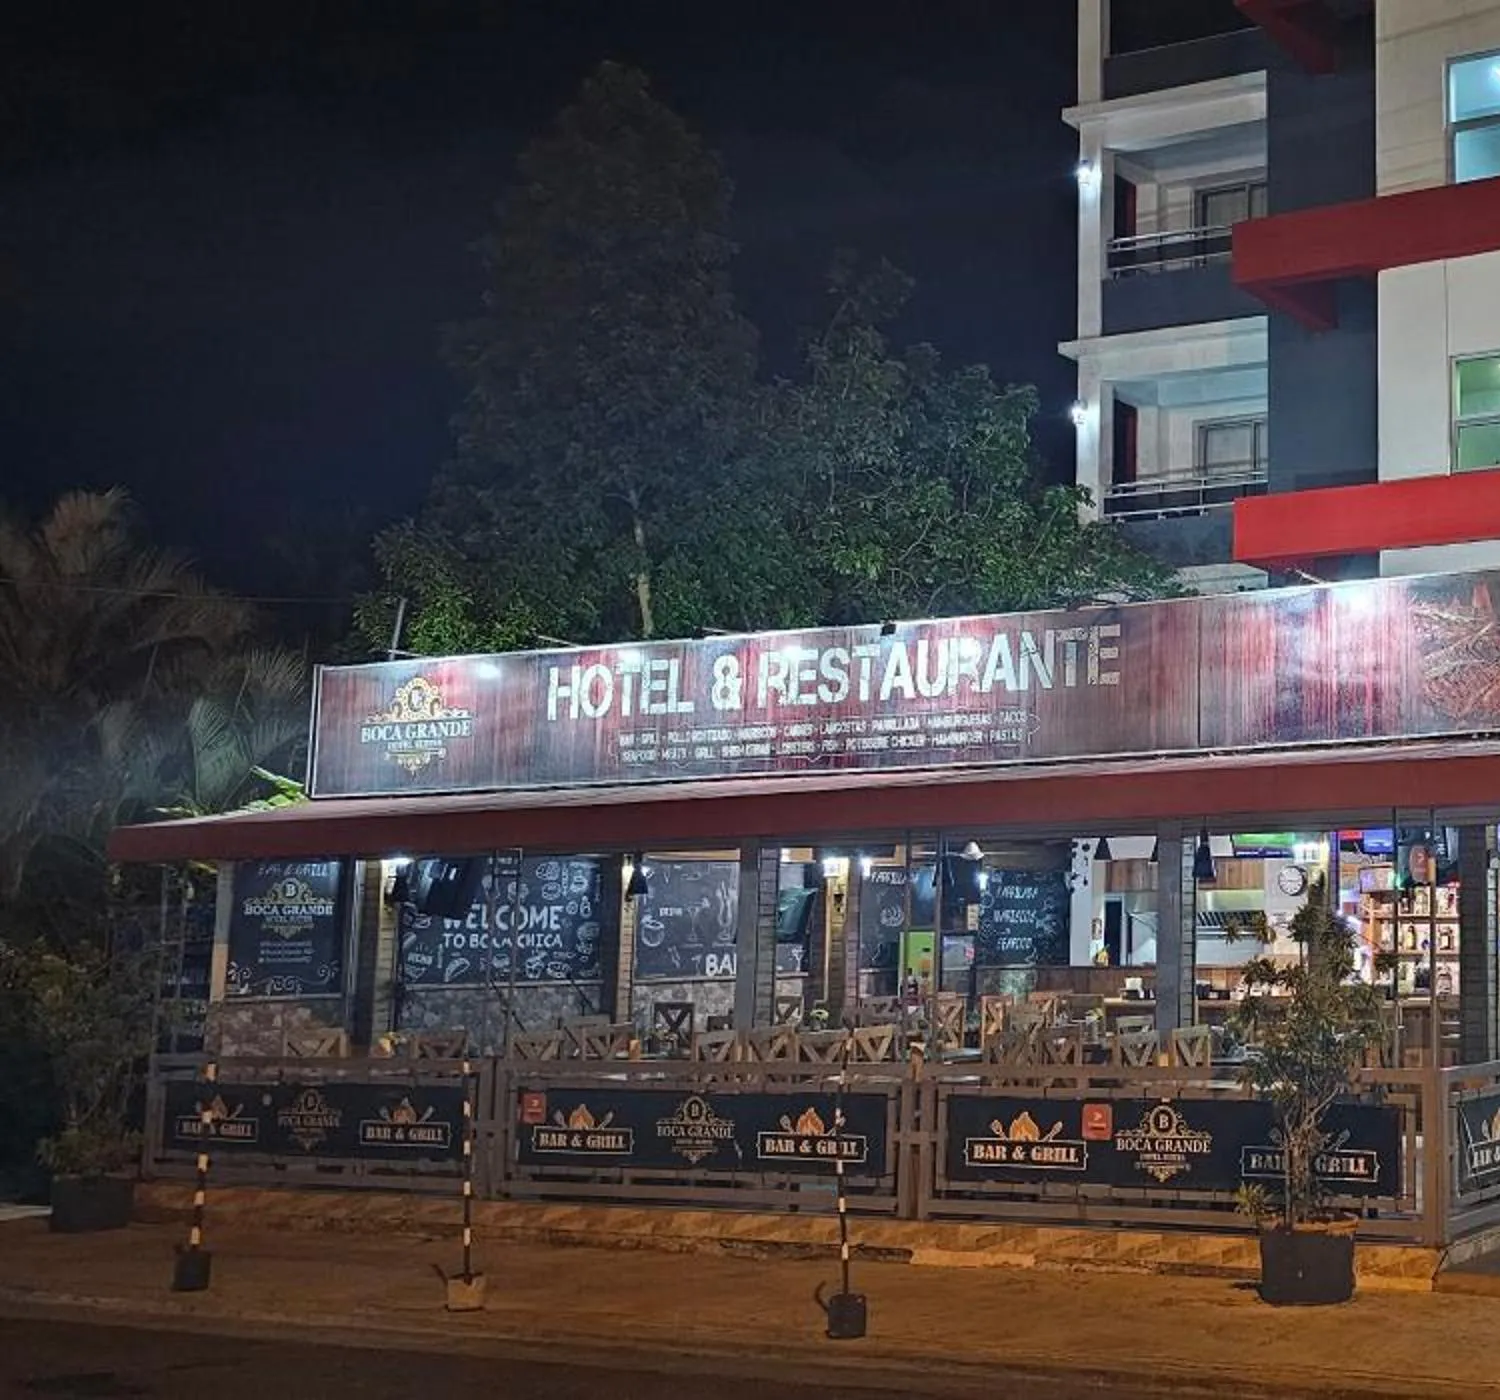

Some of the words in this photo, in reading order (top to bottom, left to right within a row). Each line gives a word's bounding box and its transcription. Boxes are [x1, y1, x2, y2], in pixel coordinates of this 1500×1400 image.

[547, 656, 695, 720] HOTEL
[711, 654, 744, 711] &
[757, 623, 1121, 709] RESTAURANTE
[361, 725, 401, 743] BOCA
[405, 719, 472, 740] GRANDE
[285, 883, 297, 897] B
[244, 903, 280, 916] BOCA
[282, 904, 334, 916] GRANDE
[443, 932, 467, 949] TO
[517, 932, 564, 949] CHICA
[1159, 1114, 1169, 1129] B
[366, 1126, 391, 1139] BAR
[408, 1127, 443, 1141] GRILL
[657, 1125, 686, 1137] BOCA
[687, 1126, 735, 1138] GRANDE
[539, 1132, 567, 1148] BAR
[570, 1132, 582, 1148] &
[586, 1134, 627, 1150] GRILL
[765, 1139, 795, 1153] BAR
[799, 1140, 812, 1153] &
[816, 1140, 859, 1156] GRLL
[1116, 1138, 1152, 1151] BOCA
[1155, 1139, 1212, 1153] GRANDE
[973, 1143, 1007, 1160] BAR
[1012, 1145, 1026, 1160] &
[1031, 1145, 1079, 1163] GRILL
[1314, 1154, 1369, 1174] GRILL
